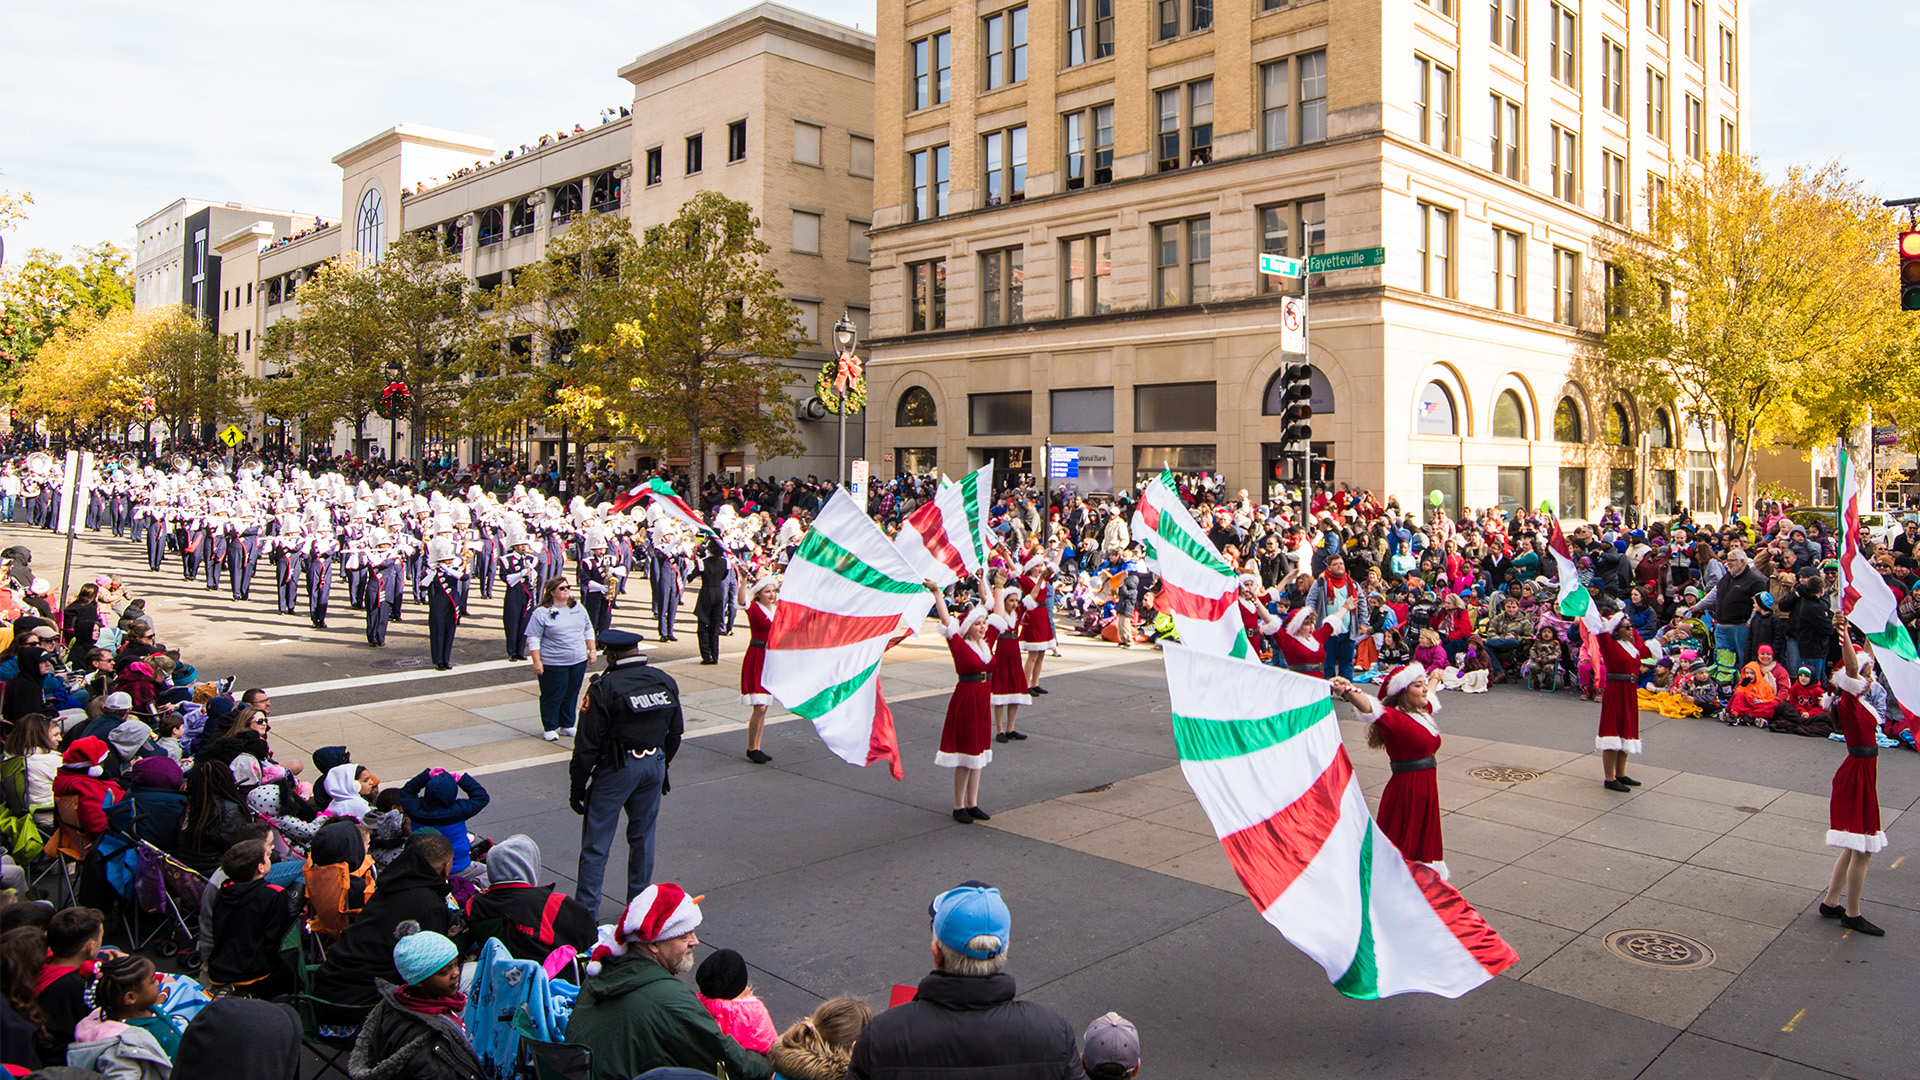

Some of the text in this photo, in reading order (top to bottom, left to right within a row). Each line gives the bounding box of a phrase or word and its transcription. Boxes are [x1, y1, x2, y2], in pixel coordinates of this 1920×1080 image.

[1310, 252, 1365, 272] Fayetteville
[1375, 248, 1383, 256] ST
[1373, 256, 1384, 264] 100
[629, 691, 672, 709] POLICE
